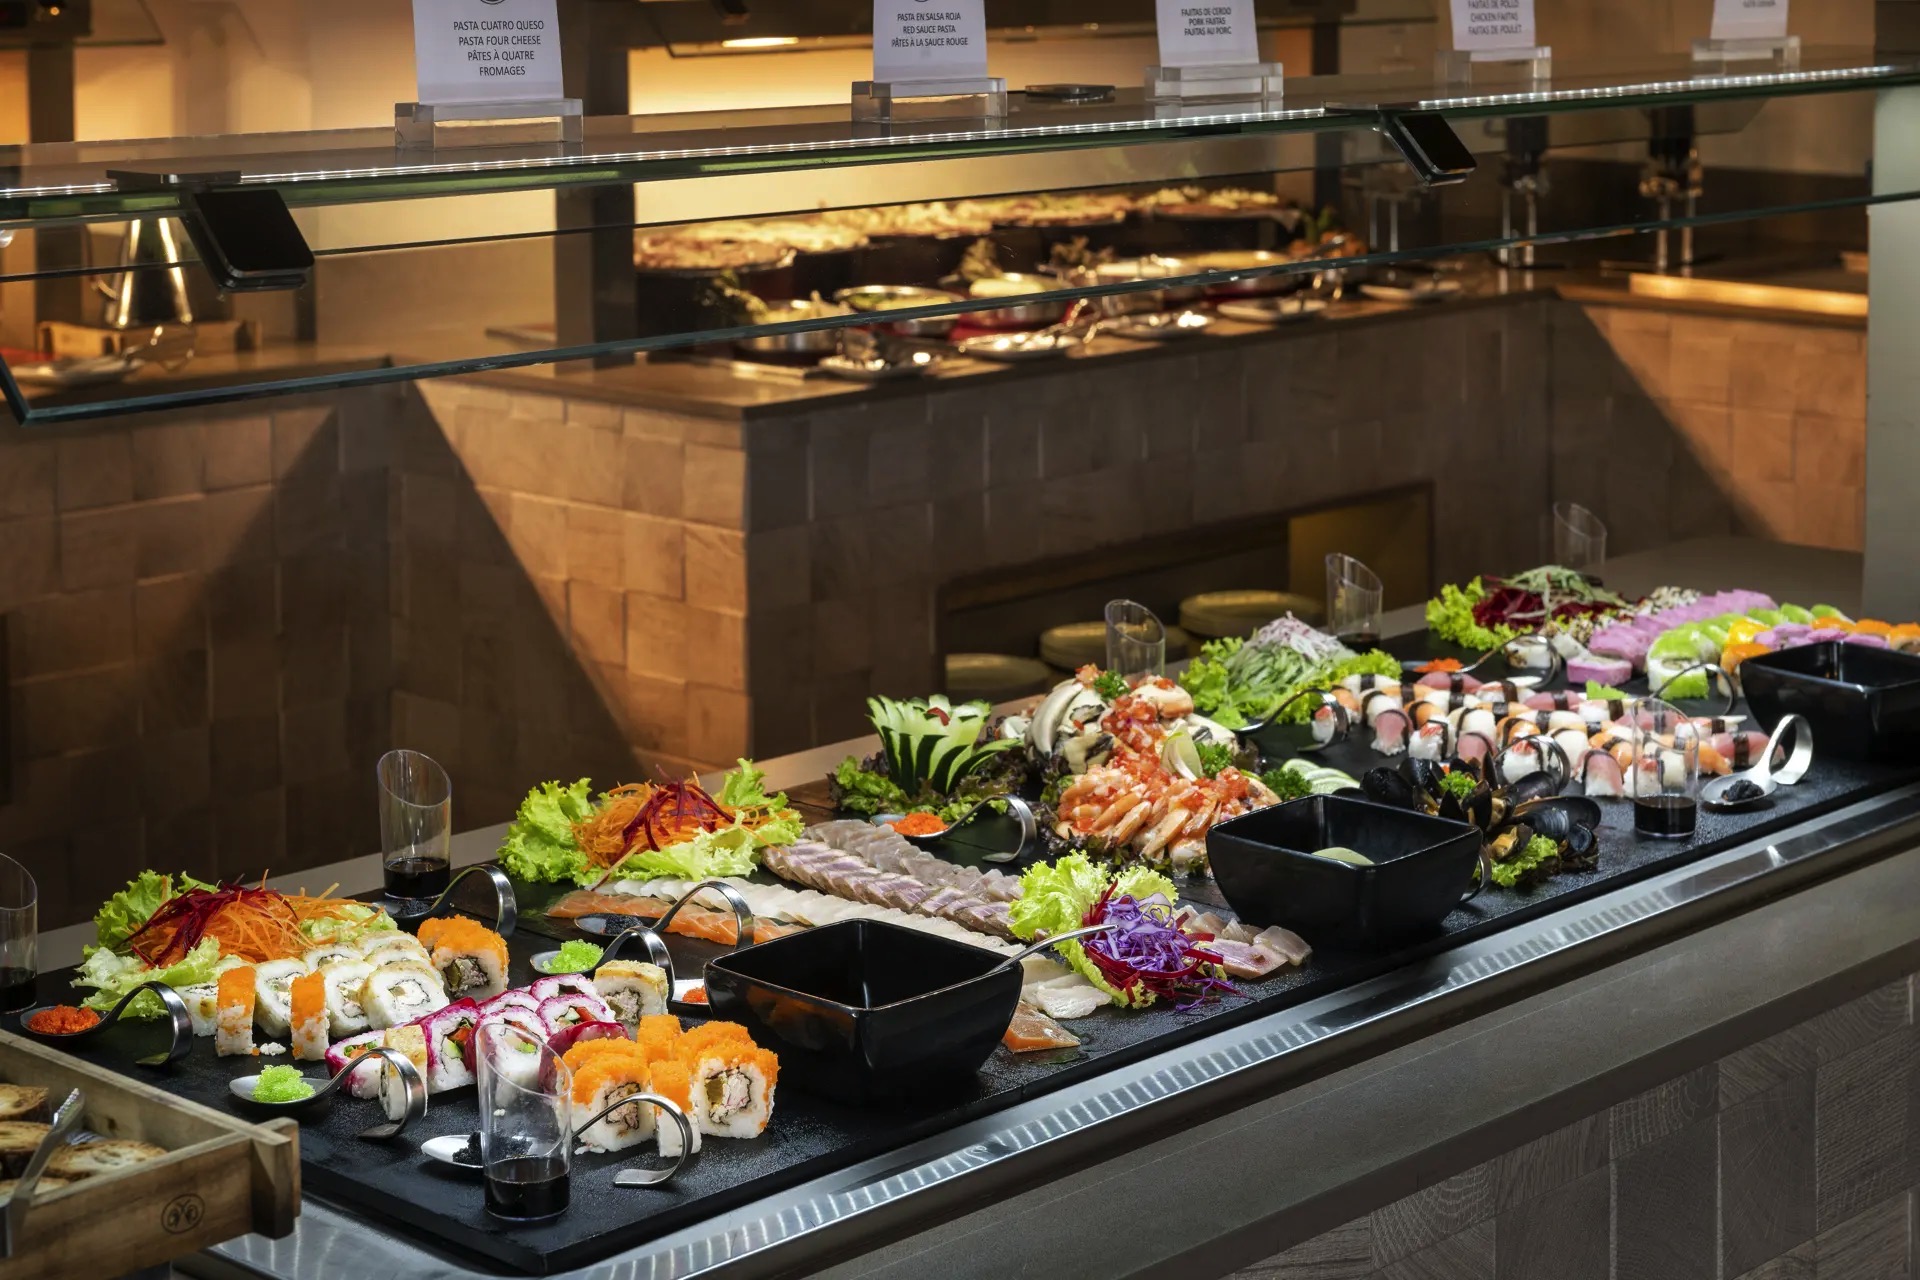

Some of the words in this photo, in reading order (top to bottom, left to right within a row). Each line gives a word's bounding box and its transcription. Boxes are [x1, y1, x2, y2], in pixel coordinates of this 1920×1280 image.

[897, 13, 915, 21] PASTA
[916, 12, 925, 21] EN
[926, 12, 944, 21] SALSA
[945, 12, 961, 20] ROJA
[453, 21, 479, 31] PASTA
[481, 20, 514, 31] CUATRO
[516, 20, 544, 31] QUESO
[903, 25, 915, 34] RED
[916, 25, 936, 34] SAUCE
[937, 25, 956, 33] PASTA
[458, 36, 484, 46] PASTA
[486, 35, 509, 45] FOUR
[511, 35, 541, 45] CHEESE
[891, 37, 909, 47] PÂTES
[916, 38, 924, 47] LA
[925, 38, 944, 47] SAUCE
[946, 37, 968, 46] ROUGE
[468, 49, 491, 61] PÂTES
[493, 49, 499, 61] À
[501, 50, 534, 61] QUATRE
[480, 66, 525, 76] FROMAGES
